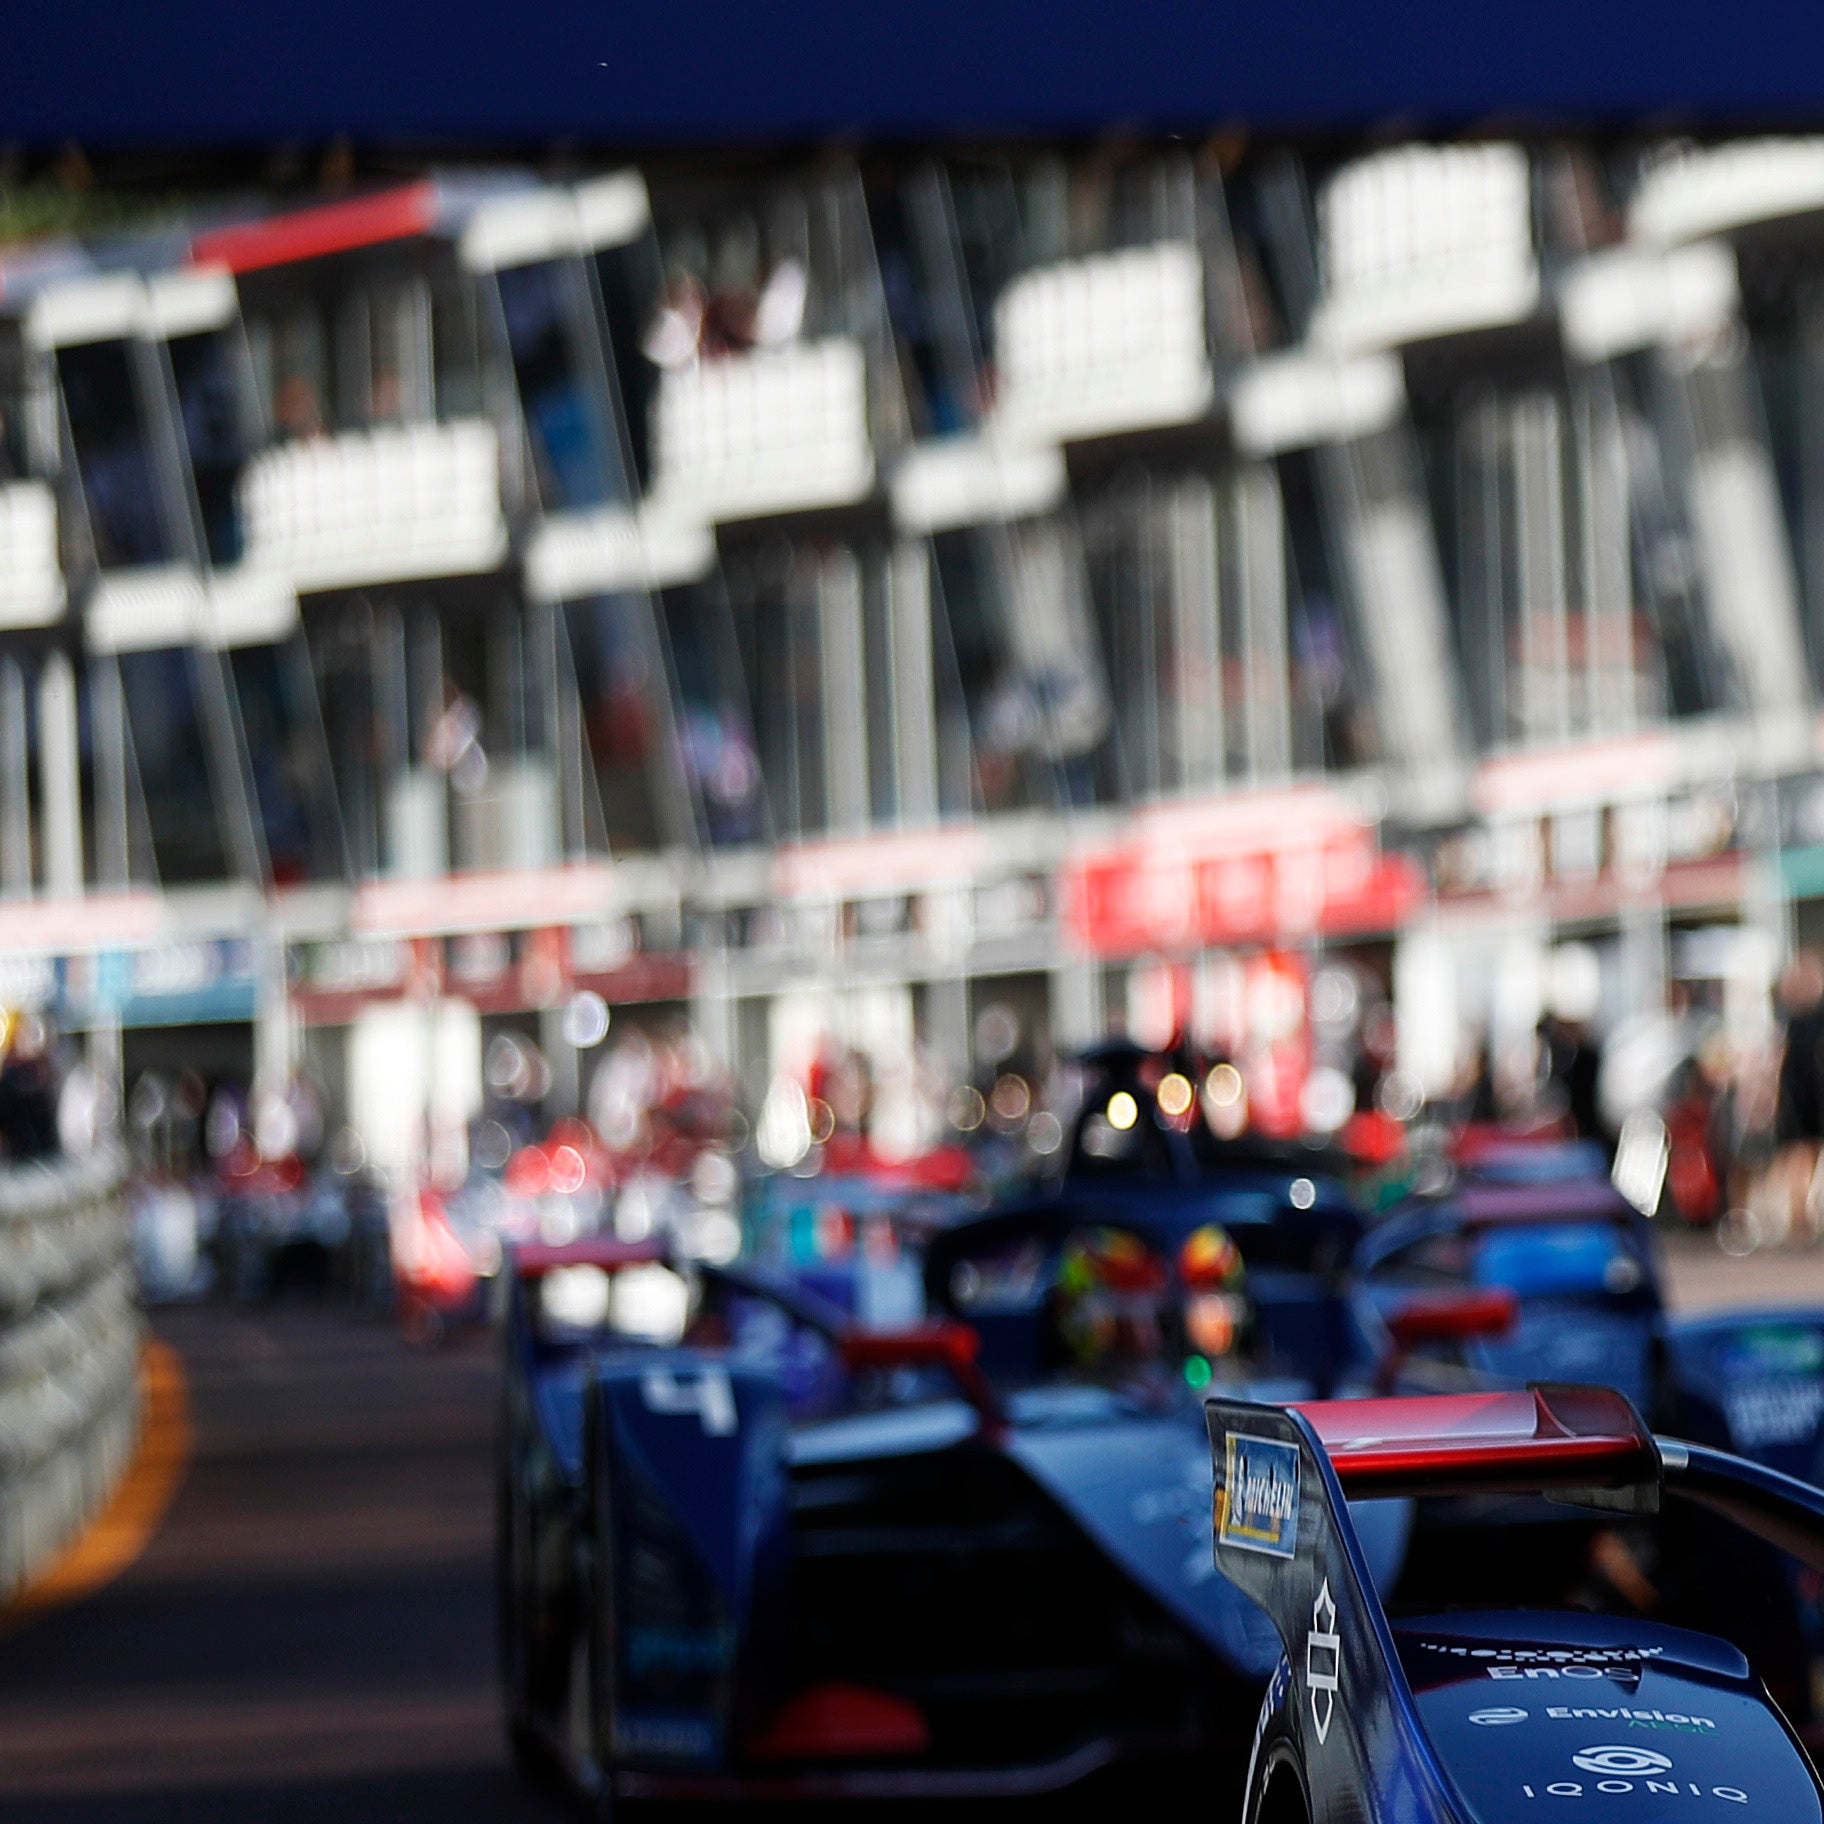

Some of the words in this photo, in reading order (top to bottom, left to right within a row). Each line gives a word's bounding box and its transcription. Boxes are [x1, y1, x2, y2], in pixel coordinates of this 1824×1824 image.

[1244, 1474, 1295, 1521] MICHELIN
[1545, 1706, 1716, 1729] Envision
[1522, 1780, 1748, 1804] IQONIQ
